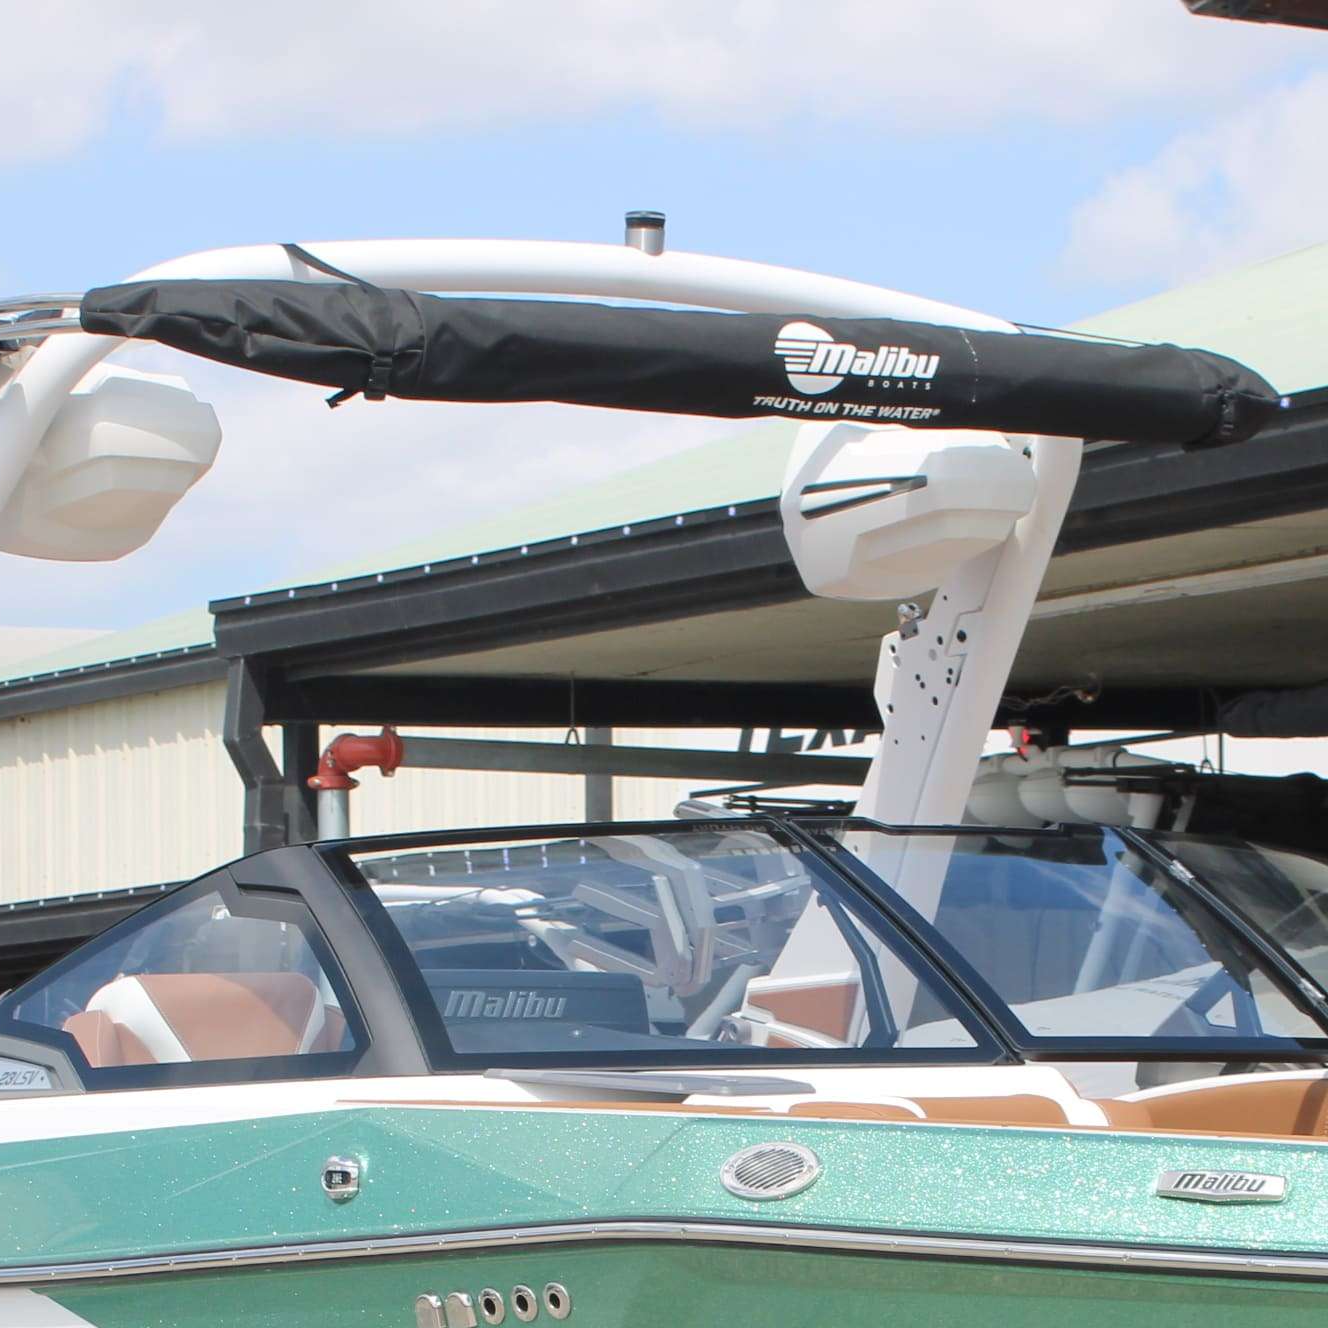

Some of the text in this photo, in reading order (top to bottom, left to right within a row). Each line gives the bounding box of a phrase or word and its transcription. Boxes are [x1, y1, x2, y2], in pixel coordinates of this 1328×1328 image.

[808, 342, 940, 378] Malibu
[868, 379, 931, 390] BOATS
[752, 396, 814, 413] TRUTH
[813, 402, 839, 415] ON
[842, 403, 876, 418] THE
[444, 990, 567, 1018] Malibu
[1173, 1173, 1266, 1192] Malibu
